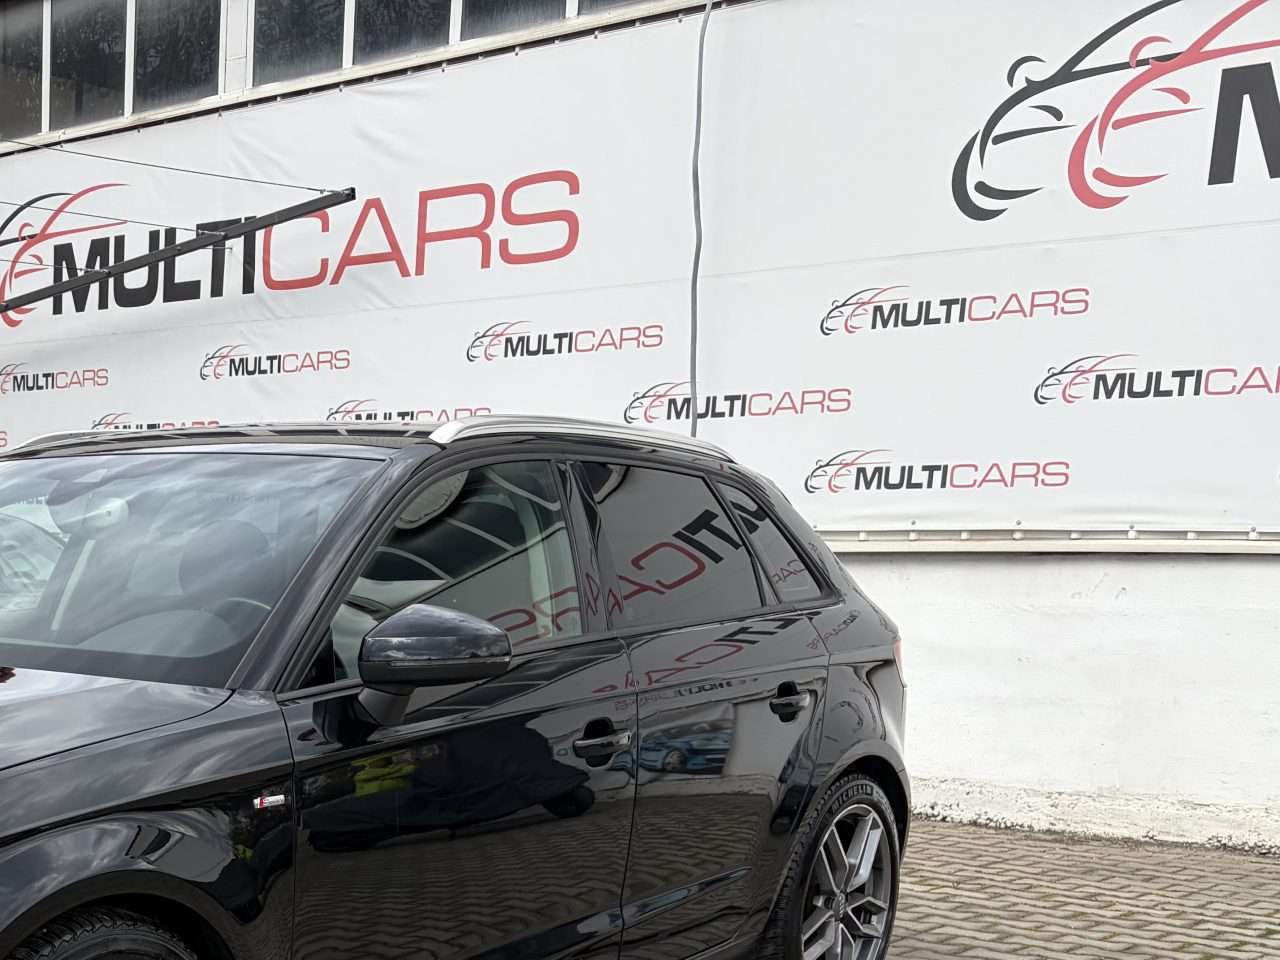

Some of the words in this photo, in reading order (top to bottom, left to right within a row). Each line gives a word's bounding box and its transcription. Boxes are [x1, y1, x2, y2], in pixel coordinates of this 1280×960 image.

[52, 169, 580, 315] MULTICARS
[870, 287, 1089, 329] MULTICARS
[503, 324, 663, 358] MULTICARS
[227, 349, 351, 377] MULTICARS
[12, 368, 109, 392] MULTICARS
[1093, 366, 1280, 400] MULTICA
[666, 388, 851, 420] MULTICARS
[854, 460, 1069, 491] MULTICARS
